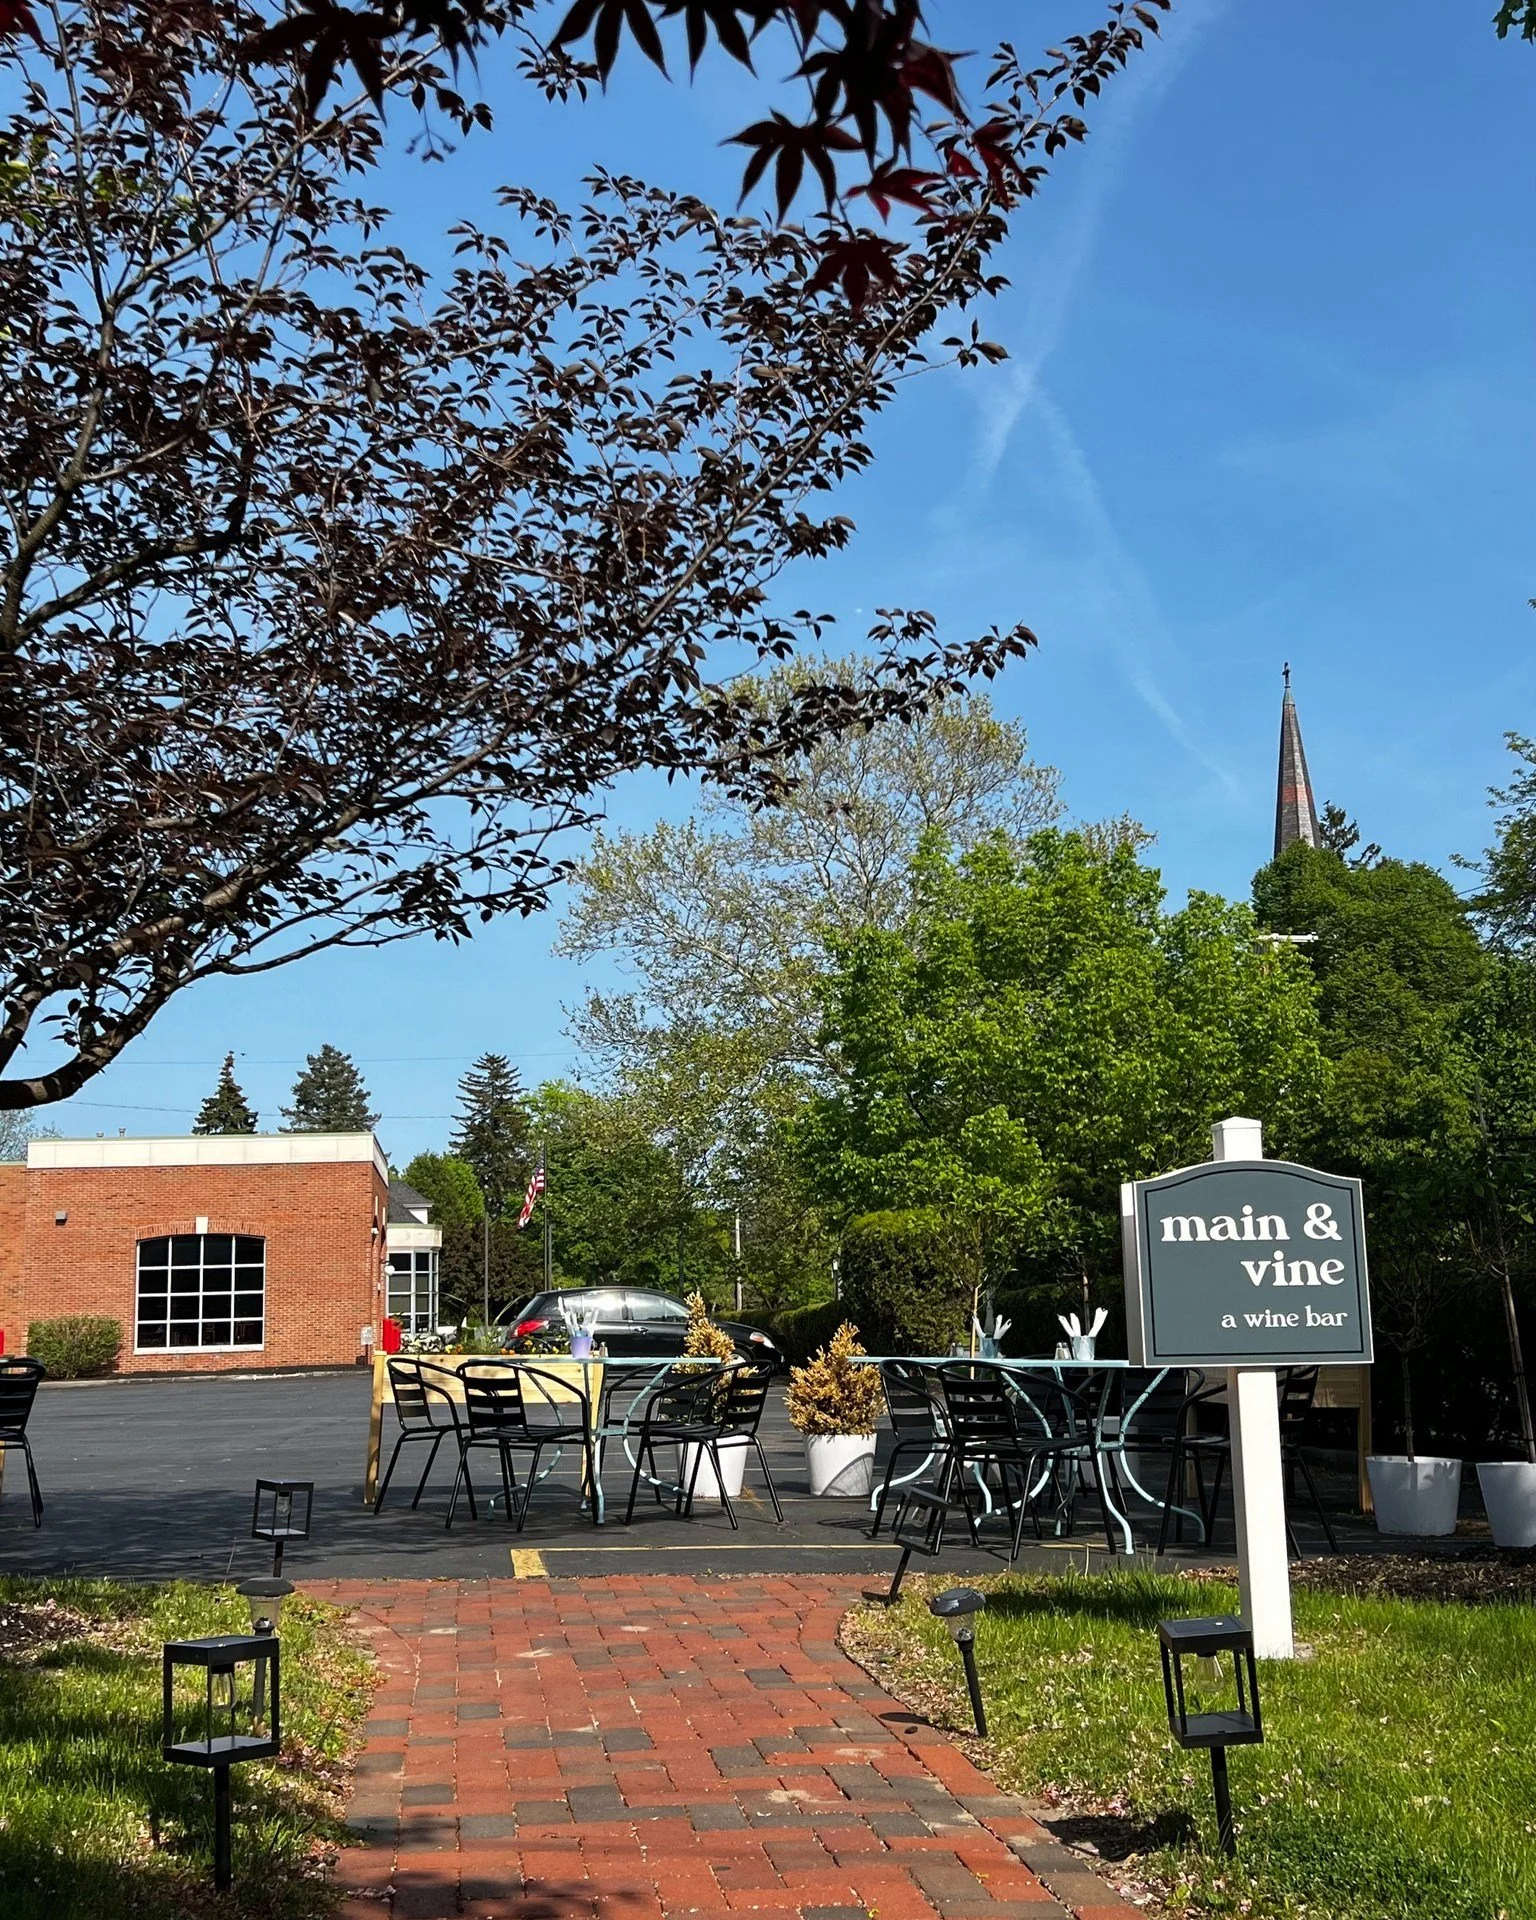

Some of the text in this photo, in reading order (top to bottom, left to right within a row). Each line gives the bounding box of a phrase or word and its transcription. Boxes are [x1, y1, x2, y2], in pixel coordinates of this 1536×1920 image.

[1159, 1202, 1343, 1242] main &
[1240, 1250, 1345, 1287] vine
[1221, 1304, 1348, 1329] a wine bar
